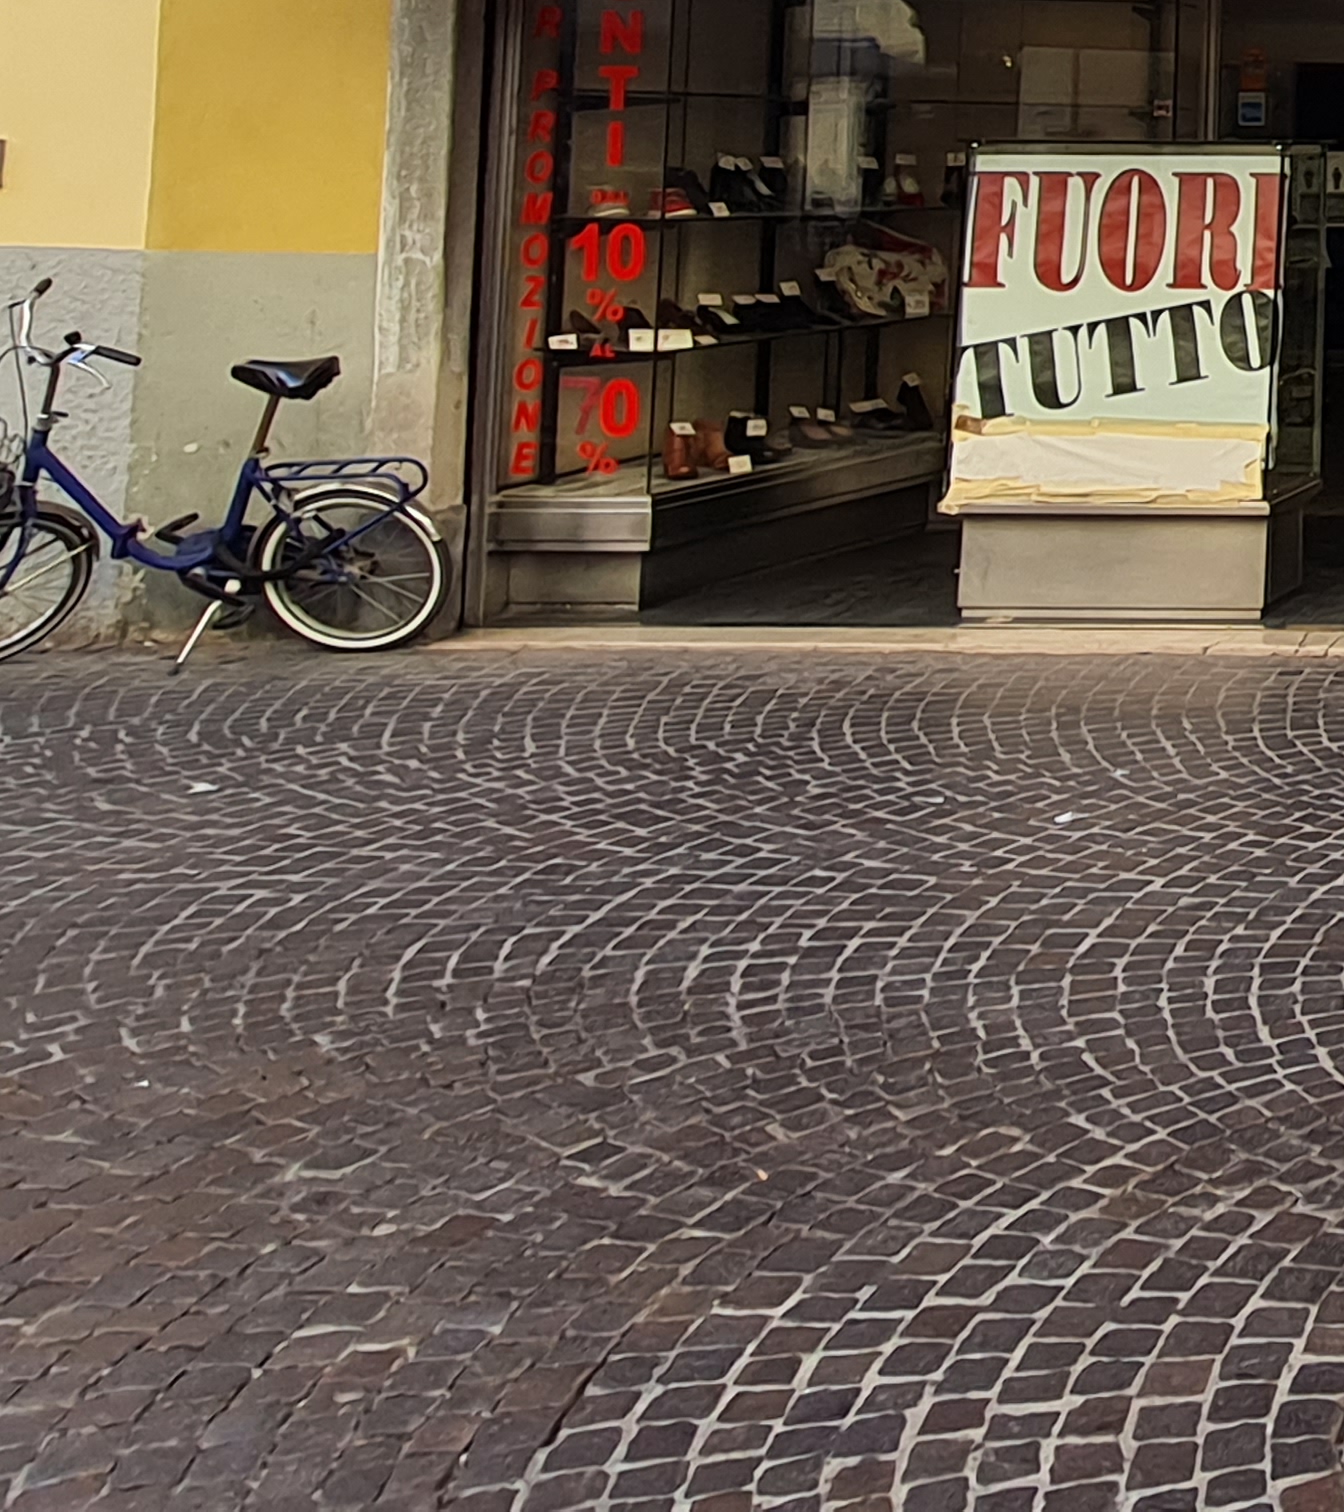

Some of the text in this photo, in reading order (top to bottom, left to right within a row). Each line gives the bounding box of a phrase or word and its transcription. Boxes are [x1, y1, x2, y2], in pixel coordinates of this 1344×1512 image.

[510, 69, 560, 475] PROMOZIONE
[570, 222, 646, 282] 10
[963, 168, 1287, 292] FUORI
[561, 375, 641, 439] 70
[957, 289, 1278, 420] TUTTO
